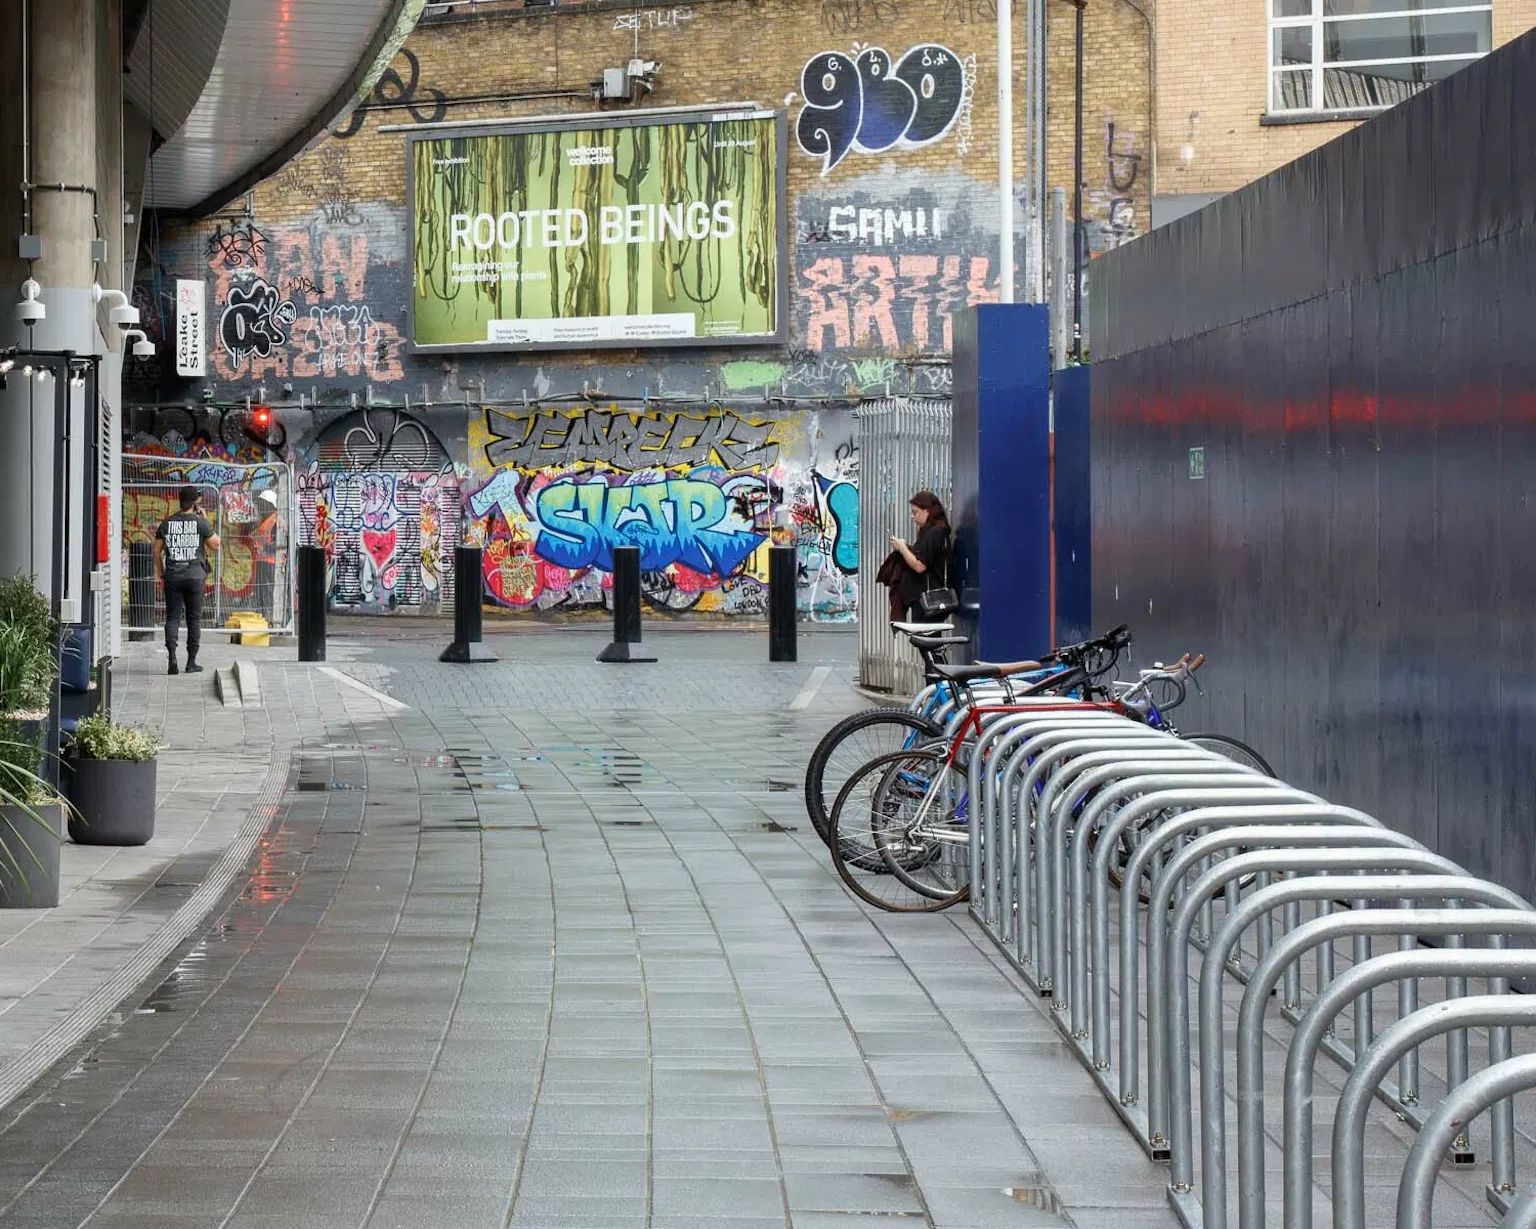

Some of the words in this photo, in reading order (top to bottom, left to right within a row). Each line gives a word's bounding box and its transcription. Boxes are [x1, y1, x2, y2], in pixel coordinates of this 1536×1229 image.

[566, 146, 612, 157] wellcome
[569, 154, 614, 166] collection
[449, 208, 589, 253] ROOTED
[600, 199, 736, 246] BEINGS
[179, 314, 188, 369] Leake
[189, 310, 199, 369] Street
[168, 520, 183, 534] THIS
[184, 520, 198, 534] BAR
[172, 534, 200, 547] CARBON
